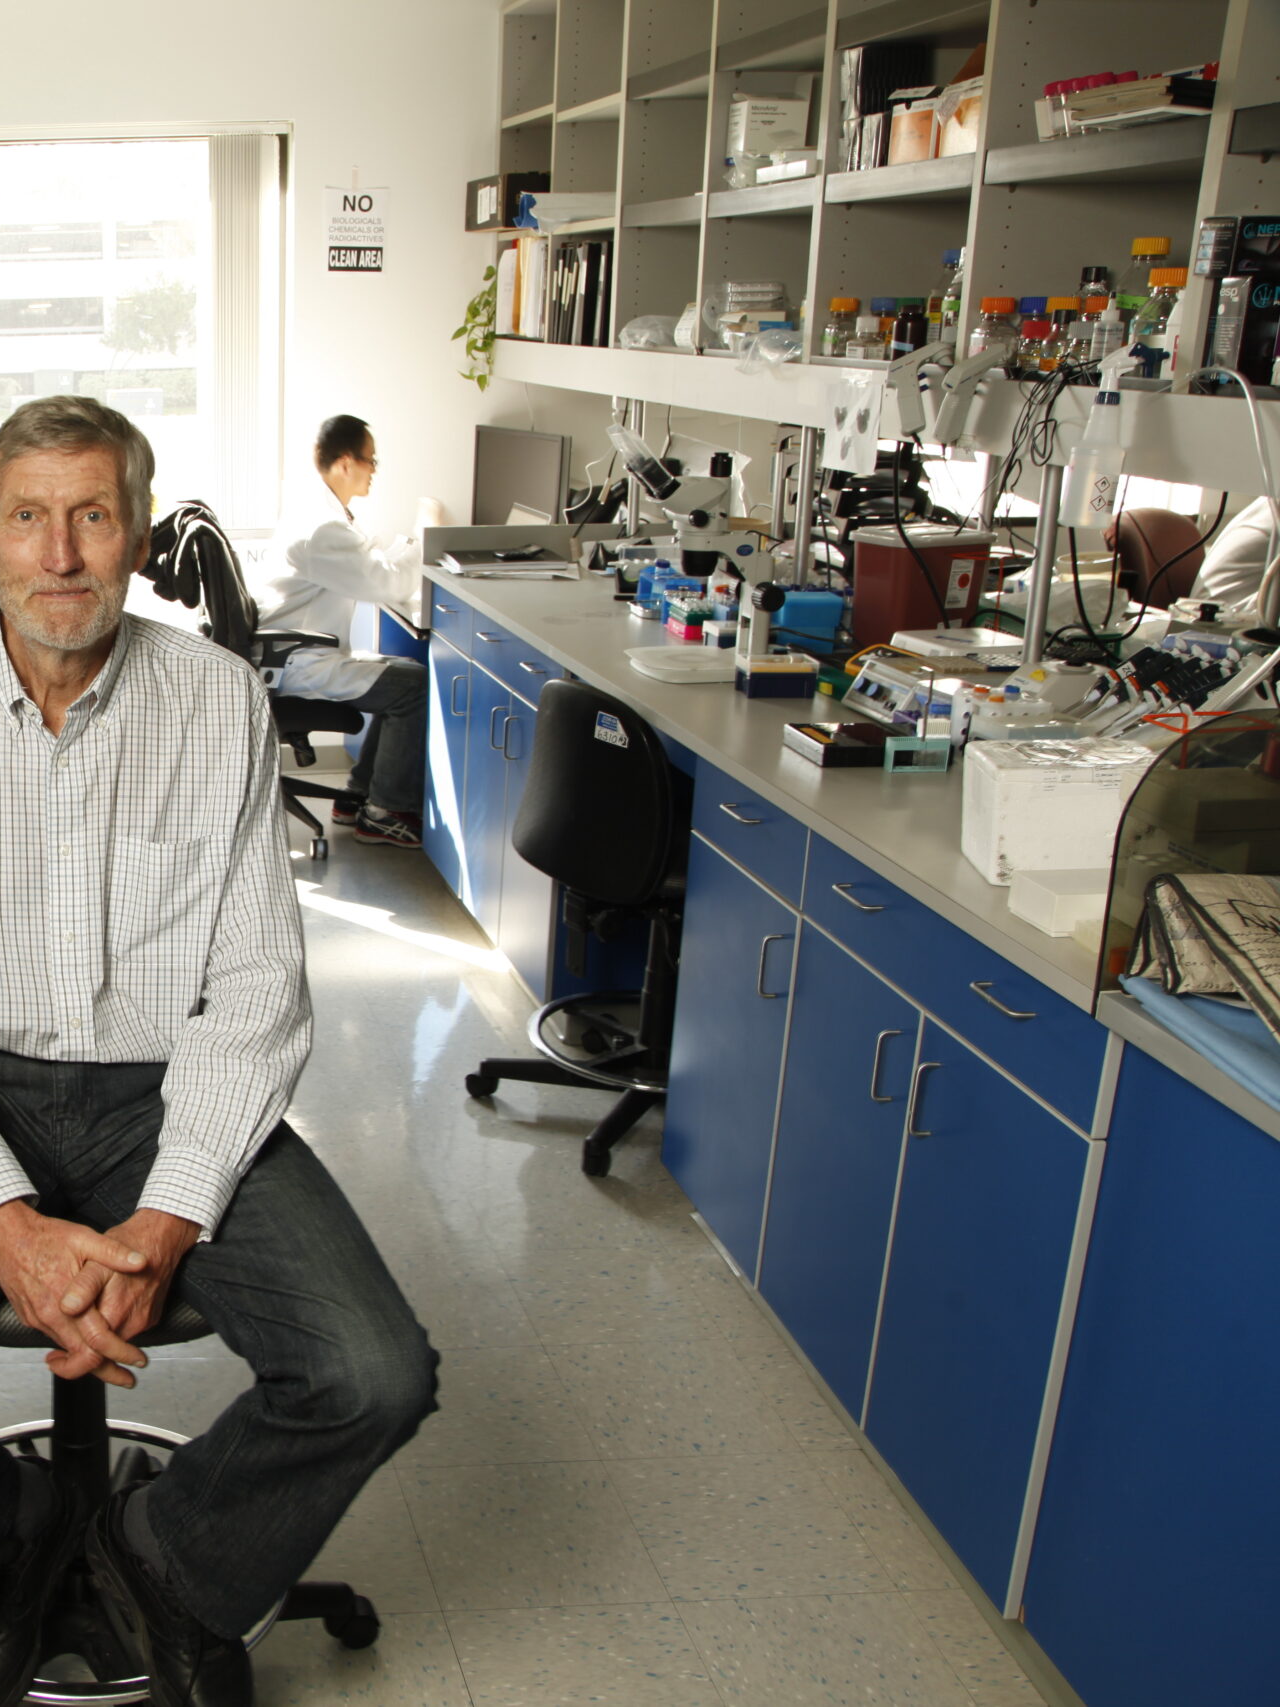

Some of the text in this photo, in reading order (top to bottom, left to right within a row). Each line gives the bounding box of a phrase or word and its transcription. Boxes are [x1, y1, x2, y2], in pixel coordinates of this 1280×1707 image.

[343, 194, 373, 212] NO
[332, 217, 382, 225] BIOLOGICALS
[328, 235, 384, 243] RADIOACTIVES
[329, 249, 382, 267] CLEAN AREA
